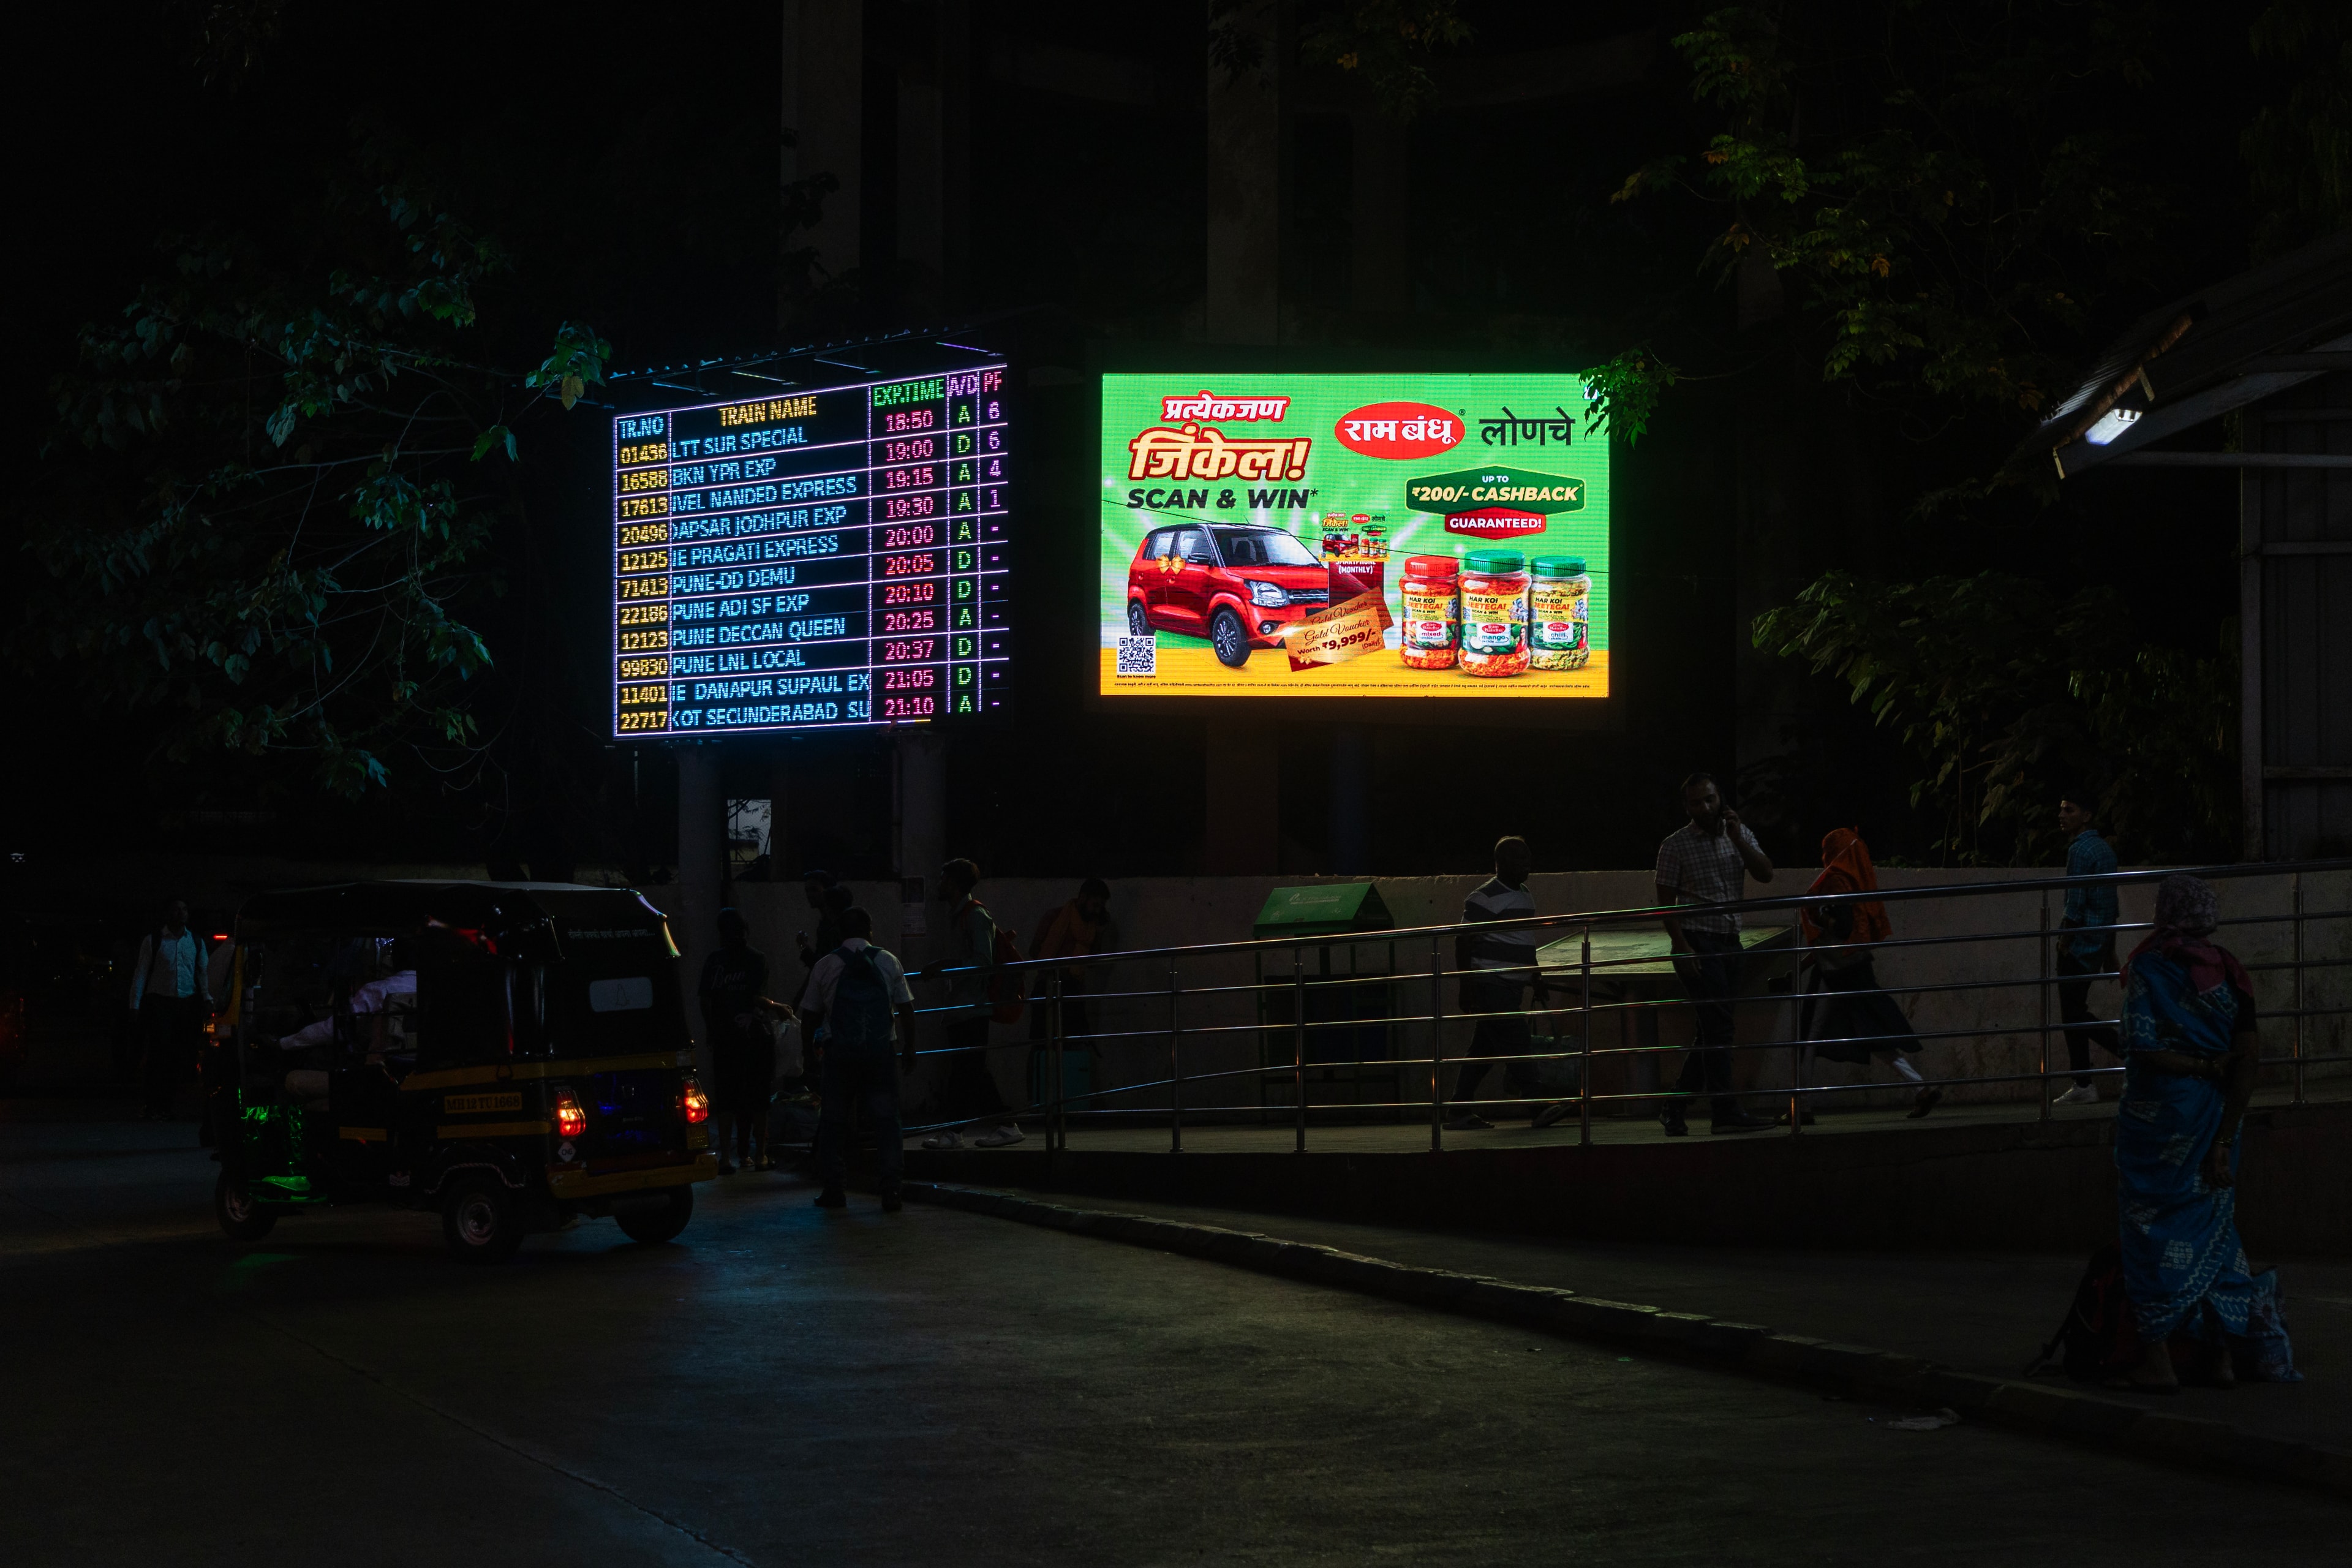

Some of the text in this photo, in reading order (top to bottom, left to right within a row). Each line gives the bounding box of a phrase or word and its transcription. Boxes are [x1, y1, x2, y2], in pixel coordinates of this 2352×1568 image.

[619, 417, 663, 439] TR.NO
[718, 403, 766, 426] TRAIN
[770, 396, 816, 420] NAME
[948, 375, 978, 397] A/D
[984, 371, 1002, 392] PF
[1164, 392, 1288, 421] प्रत्येकजण
[620, 443, 668, 464] 01436
[673, 439, 700, 458] LTT
[704, 435, 736, 454] SUR
[740, 427, 807, 450] SPECIAL
[886, 410, 933, 432] 18:50
[959, 405, 970, 423] A
[1344, 415, 1457, 444] राम बंधू
[1479, 406, 1575, 446] लोणचे
[621, 431, 1000, 491] 16588 BKN YPR EXP 19:00 D 6
[1129, 424, 1311, 480] जिंकेल!
[621, 497, 668, 517] 17613
[710, 485, 777, 508] NANDED
[782, 476, 856, 500] EXPRESS
[886, 467, 933, 488] 19:15
[958, 463, 971, 481] A
[989, 459, 1001, 477] 4
[1127, 488, 1209, 509] SCAN
[1216, 489, 1236, 509] &
[1412, 486, 1469, 502] ₹200/-
[620, 524, 668, 545] 20496
[735, 510, 809, 536] JODHPUR
[813, 506, 846, 526] EXP
[886, 496, 933, 518] 19:30
[957, 492, 971, 511] A
[990, 489, 1000, 508] 1
[1449, 517, 1543, 529] GUARANTEED!
[620, 551, 668, 571] 12125
[691, 542, 760, 565] PRAGATI
[764, 535, 838, 558] EXPRESS
[886, 525, 933, 546] 20:00
[958, 522, 971, 540] A
[620, 578, 668, 598] 71413
[673, 571, 744, 594] PUNE-DD
[747, 566, 794, 587] DEMU
[886, 554, 934, 575] 20:05
[958, 551, 971, 568] D
[1338, 565, 1373, 575] (MONTHLY)
[673, 601, 715, 620] PUNE
[718, 599, 747, 617] ADI
[751, 597, 772, 614] SF
[775, 594, 809, 612] EXP
[886, 583, 934, 603] 20:10
[958, 581, 971, 598] D
[1333, 601, 1368, 617] Voucher
[673, 627, 715, 646] PUNE
[718, 622, 783, 643] DECCAN
[788, 617, 845, 641] QUEEN
[886, 611, 933, 631] 20:25
[960, 608, 971, 626] A
[1297, 628, 1376, 655] Worth ₹9,999/-
[1304, 619, 1370, 646] Gold Voucher
[620, 658, 668, 677] 99830
[673, 655, 715, 674] PUNE
[718, 653, 749, 671] LNL
[752, 649, 805, 669] LOCAL
[885, 640, 933, 660] 20:37
[958, 638, 971, 655] D
[620, 685, 668, 704] 11401
[694, 679, 772, 700] DANAPUR
[777, 675, 842, 695] SUPAUL
[848, 674, 869, 691] EX
[885, 669, 933, 688] 21:05
[958, 668, 971, 685] D
[620, 711, 668, 729] 22717
[706, 703, 838, 725] SECUNDERABAD
[885, 697, 933, 716] 21:10
[959, 695, 971, 712] A
